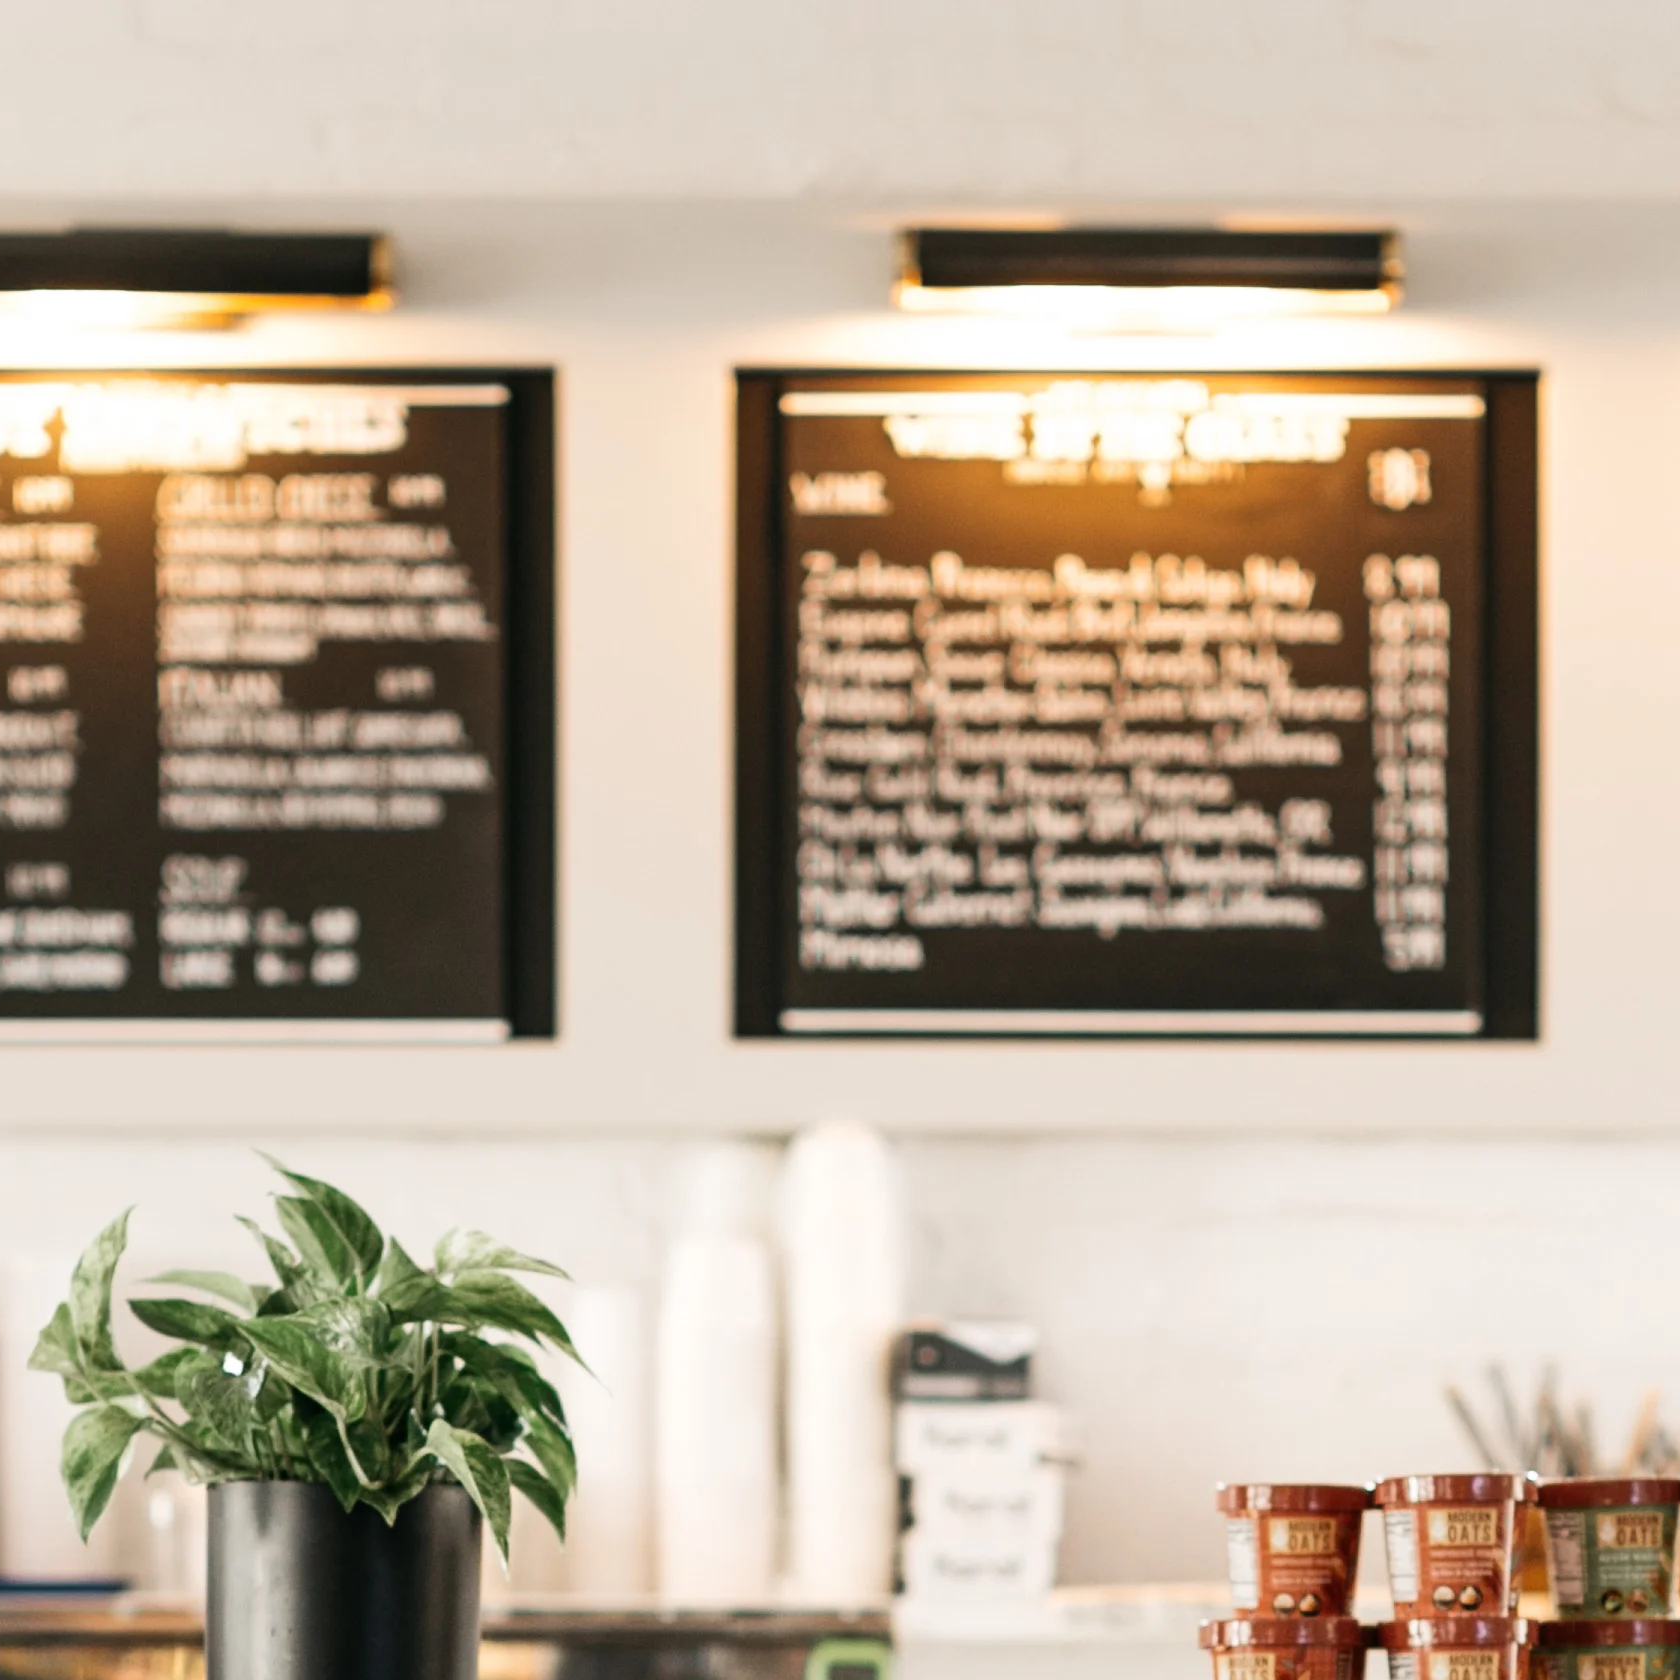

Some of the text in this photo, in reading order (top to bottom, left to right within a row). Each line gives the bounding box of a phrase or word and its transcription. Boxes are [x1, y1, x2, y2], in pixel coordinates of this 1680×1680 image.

[1448, 1512, 1492, 1524] MODERN
[1616, 1515, 1659, 1526] MODERN
[1288, 1520, 1332, 1532] MODERN
[1448, 1525, 1492, 1542] OATS
[1619, 1529, 1659, 1546] OATS
[1289, 1534, 1332, 1550] OATS
[1228, 1656, 1268, 1666] MODERN
[1449, 1657, 1493, 1666] MODERN
[1594, 1655, 1640, 1666] MODERN
